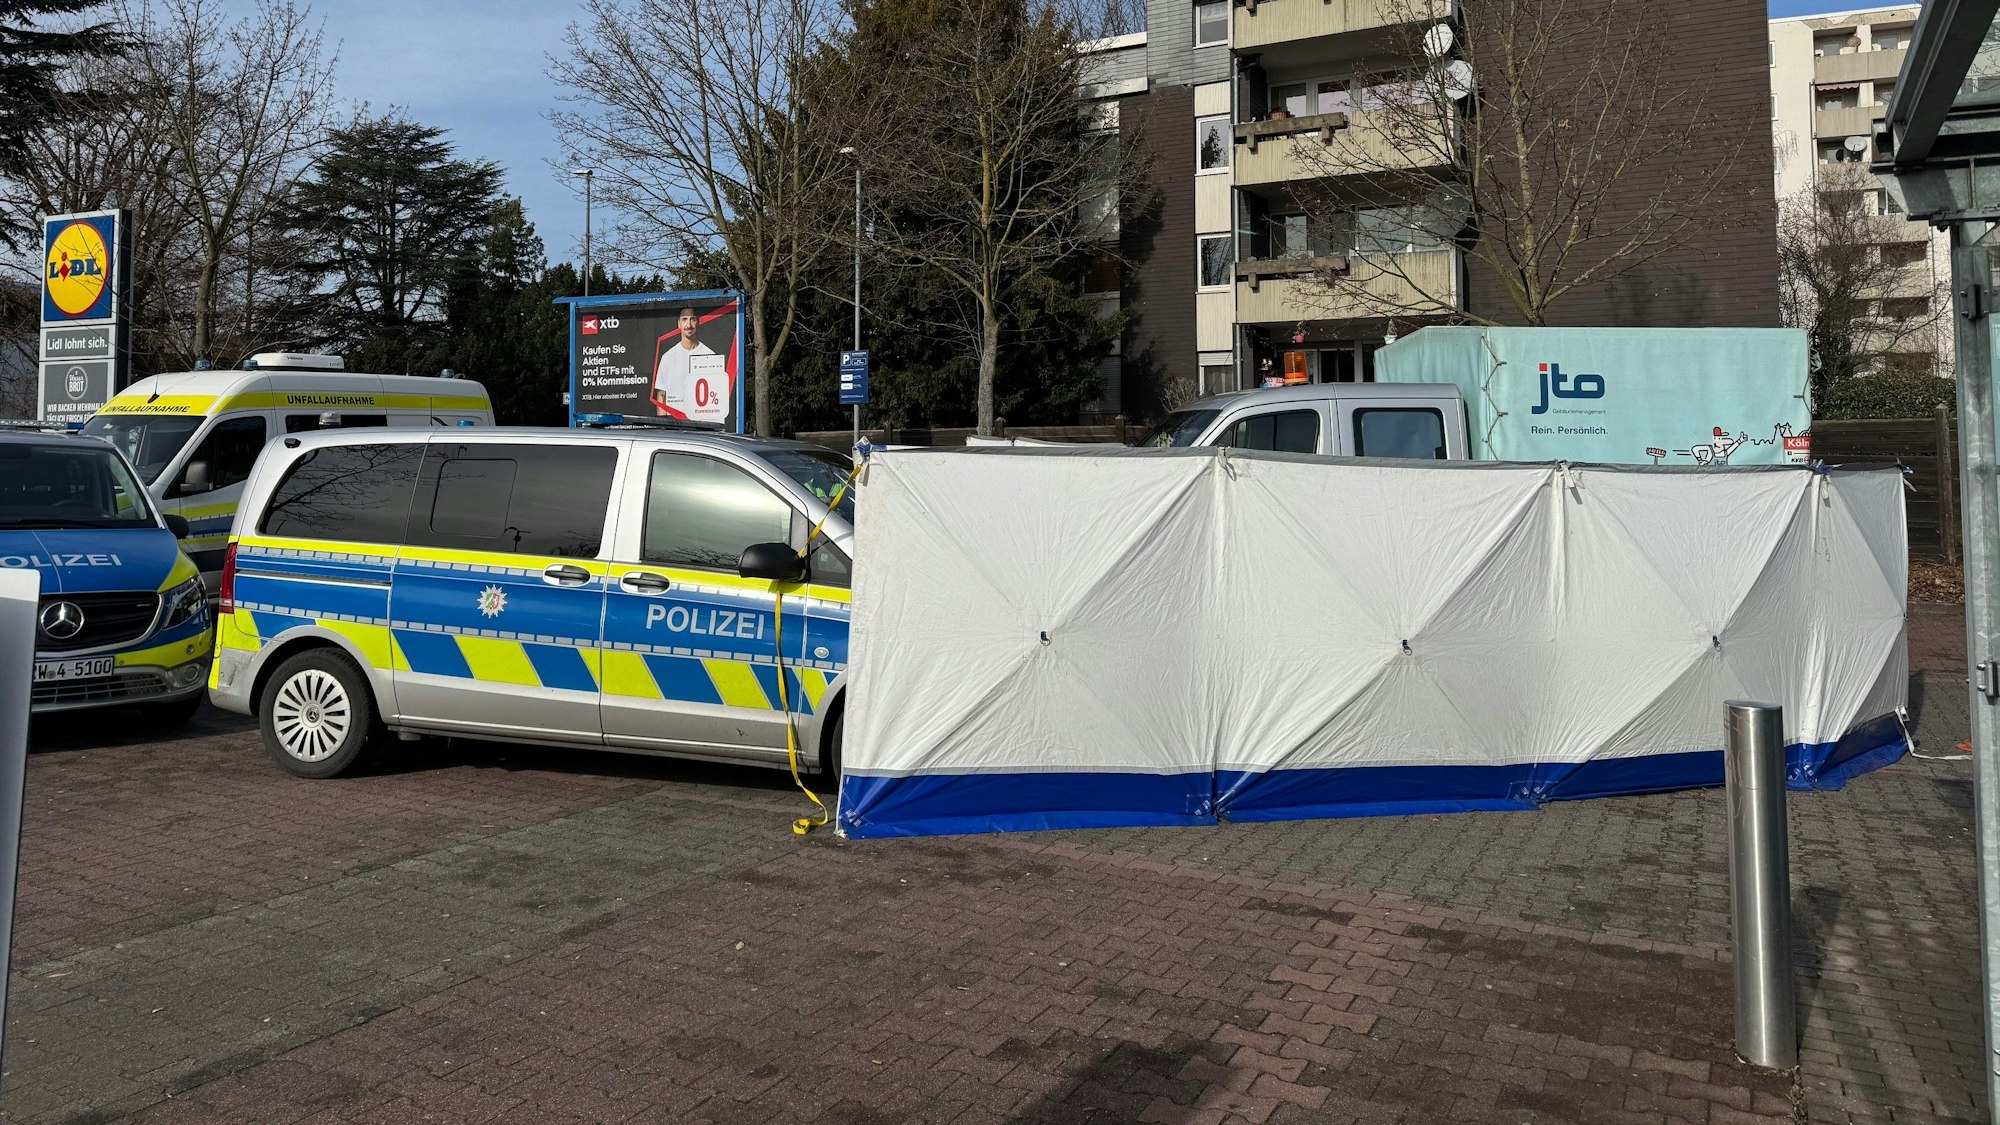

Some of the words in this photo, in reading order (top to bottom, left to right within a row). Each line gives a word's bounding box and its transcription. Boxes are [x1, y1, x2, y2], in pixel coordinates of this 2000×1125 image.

[600, 315, 620, 329] xtb
[47, 338, 62, 350] Lidl
[65, 337, 86, 349] lohnt
[88, 336, 108, 348] sich.
[582, 345, 611, 355] Kaufen
[612, 344, 626, 354] Sie
[582, 357, 609, 366] Aktien
[842, 354, 850, 365] P
[582, 367, 598, 376] und
[600, 366, 620, 375] ETFs
[621, 365, 635, 374] mit
[69, 381, 84, 392] BROT
[582, 378, 596, 387] 0%
[597, 375, 648, 386] Kommission
[1531, 363, 1605, 414] jto
[287, 395, 375, 405] UNFALLAUFNAHME
[46, 403, 57, 412] WIR
[58, 403, 76, 412] BACKEN
[105, 405, 191, 413] UNFALLAUFNAHME
[1531, 426, 1555, 434] Rein.
[1558, 426, 1609, 435] Persönlich.
[645, 603, 765, 640] POLIZEI
